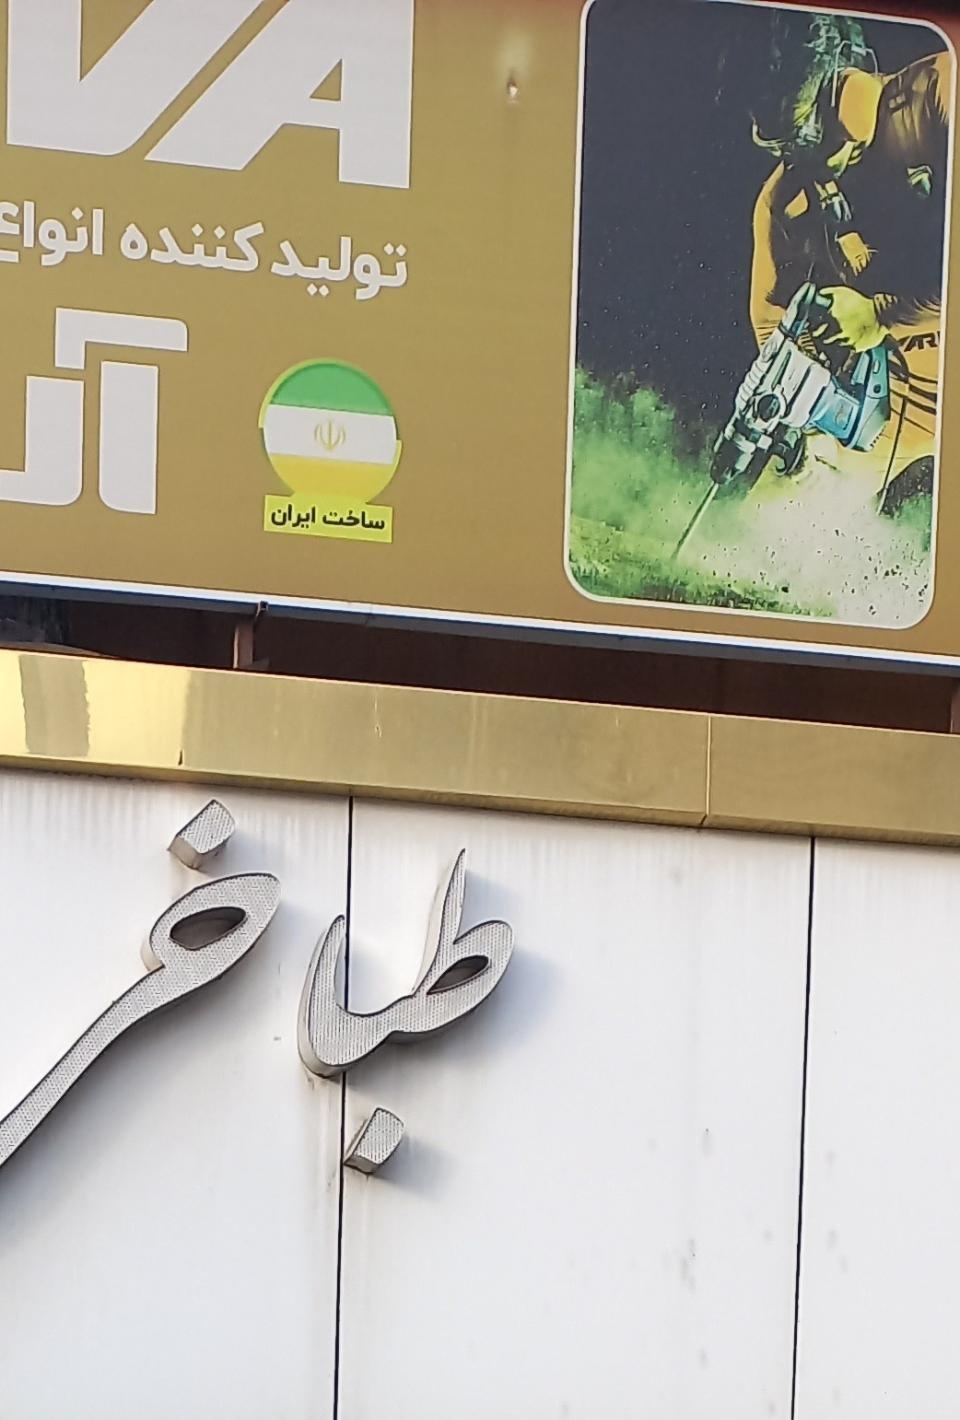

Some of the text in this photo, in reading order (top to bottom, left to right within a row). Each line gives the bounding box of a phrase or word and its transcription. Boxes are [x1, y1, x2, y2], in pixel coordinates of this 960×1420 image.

[120, 222, 265, 273] کننده
[271, 236, 408, 299] تولید
[271, 503, 385, 530] ساخت ایران
